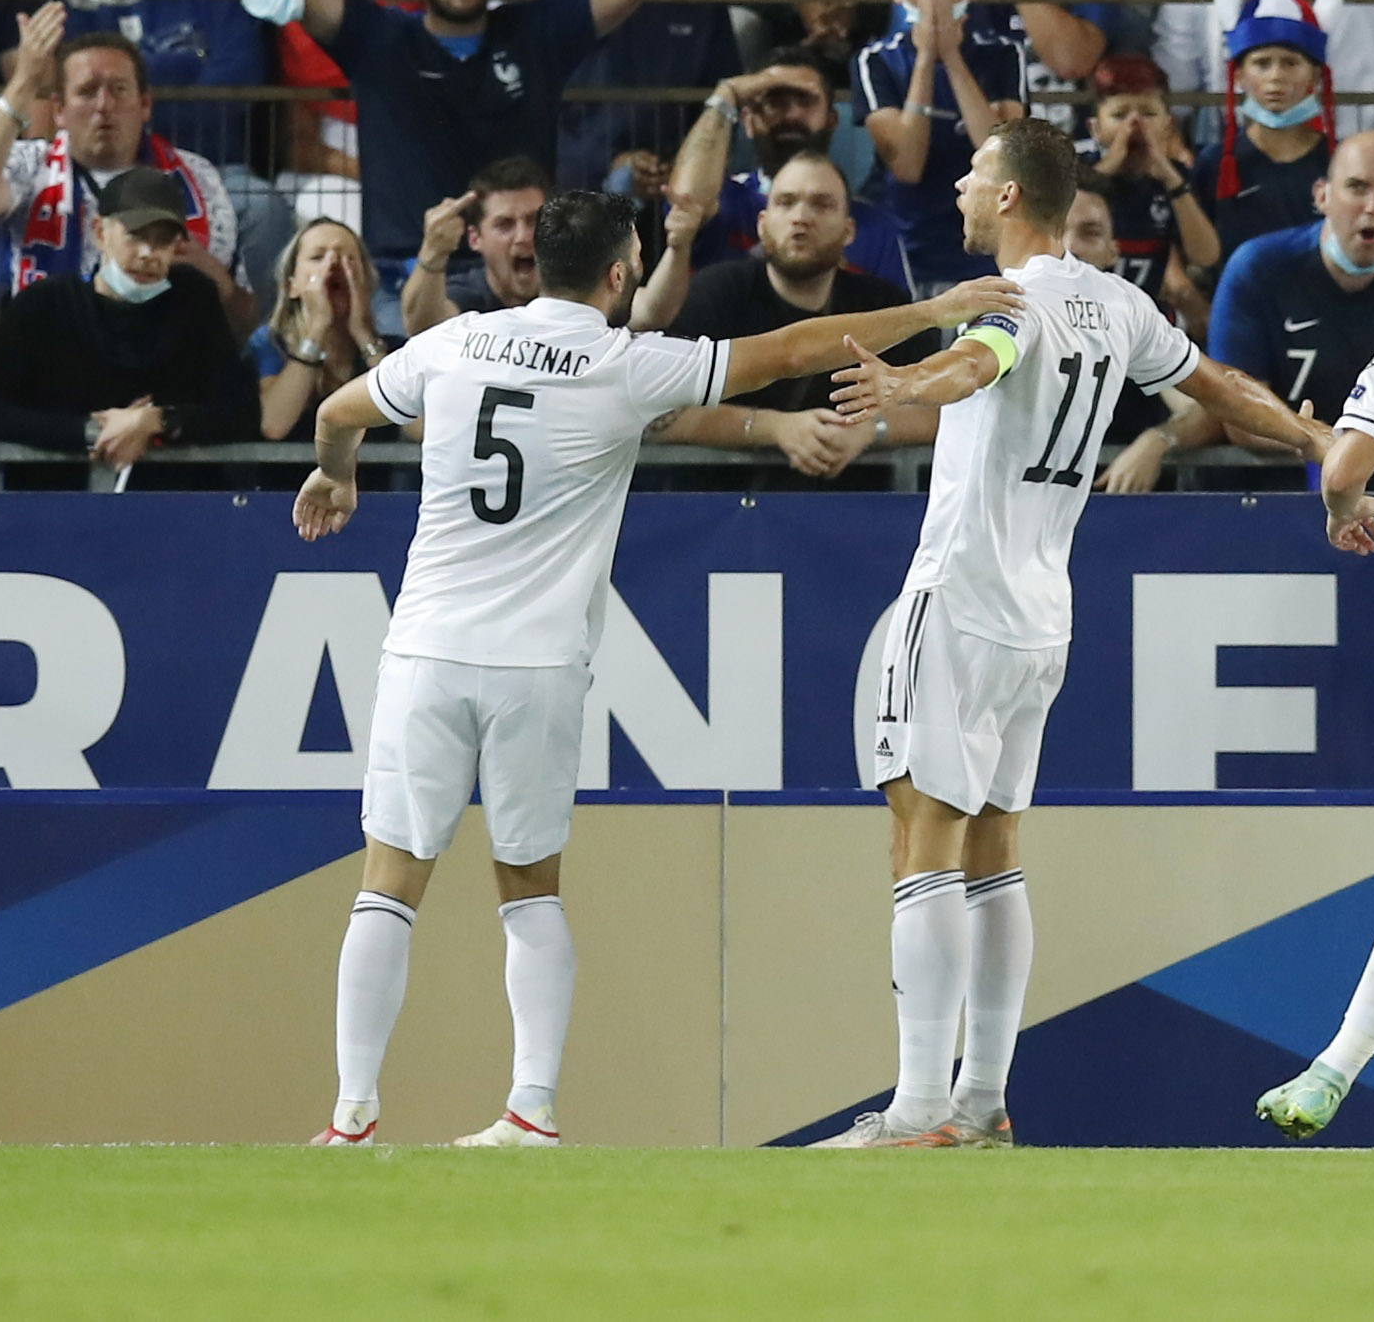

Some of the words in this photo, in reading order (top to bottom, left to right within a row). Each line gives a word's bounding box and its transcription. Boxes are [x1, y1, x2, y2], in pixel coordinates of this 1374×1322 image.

[1021, 351, 1111, 489] 11
[1286, 348, 1318, 402] 7
[470, 385, 535, 525] 5
